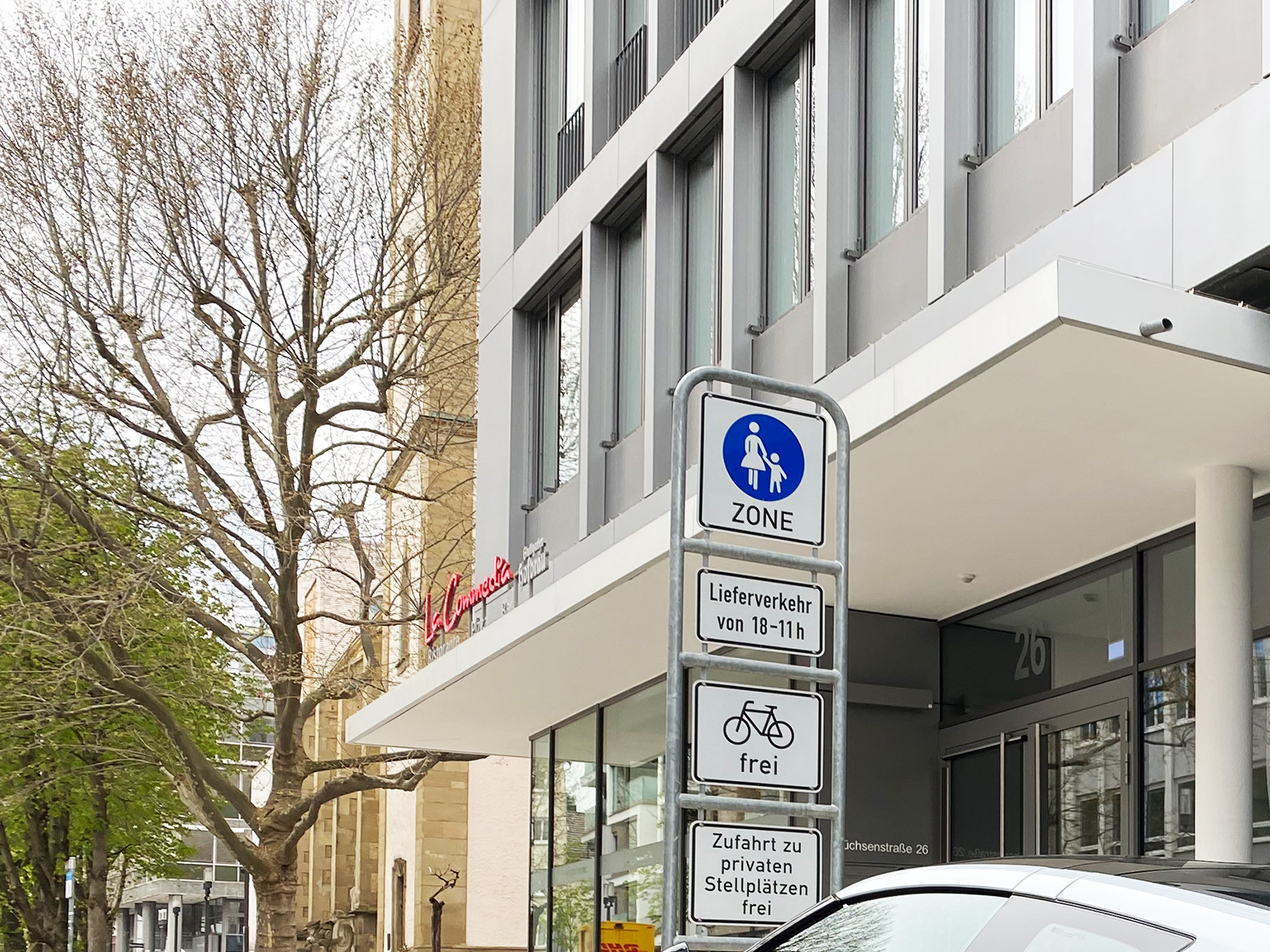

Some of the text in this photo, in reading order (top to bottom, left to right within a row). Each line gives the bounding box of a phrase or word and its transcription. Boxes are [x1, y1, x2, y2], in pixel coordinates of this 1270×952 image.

[731, 502, 794, 532] ZONE
[443, 557, 513, 632] Commedia
[709, 582, 812, 613] Lieferverkehr
[717, 616, 744, 632] von
[1014, 621, 1046, 681] 26
[740, 753, 779, 777] frei
[712, 832, 802, 854] Zufahrt zu
[844, 839, 929, 855] üchsenstraße 26
[721, 856, 793, 877] privaten
[704, 873, 809, 899] Stellplätzen
[742, 899, 772, 917] frei
